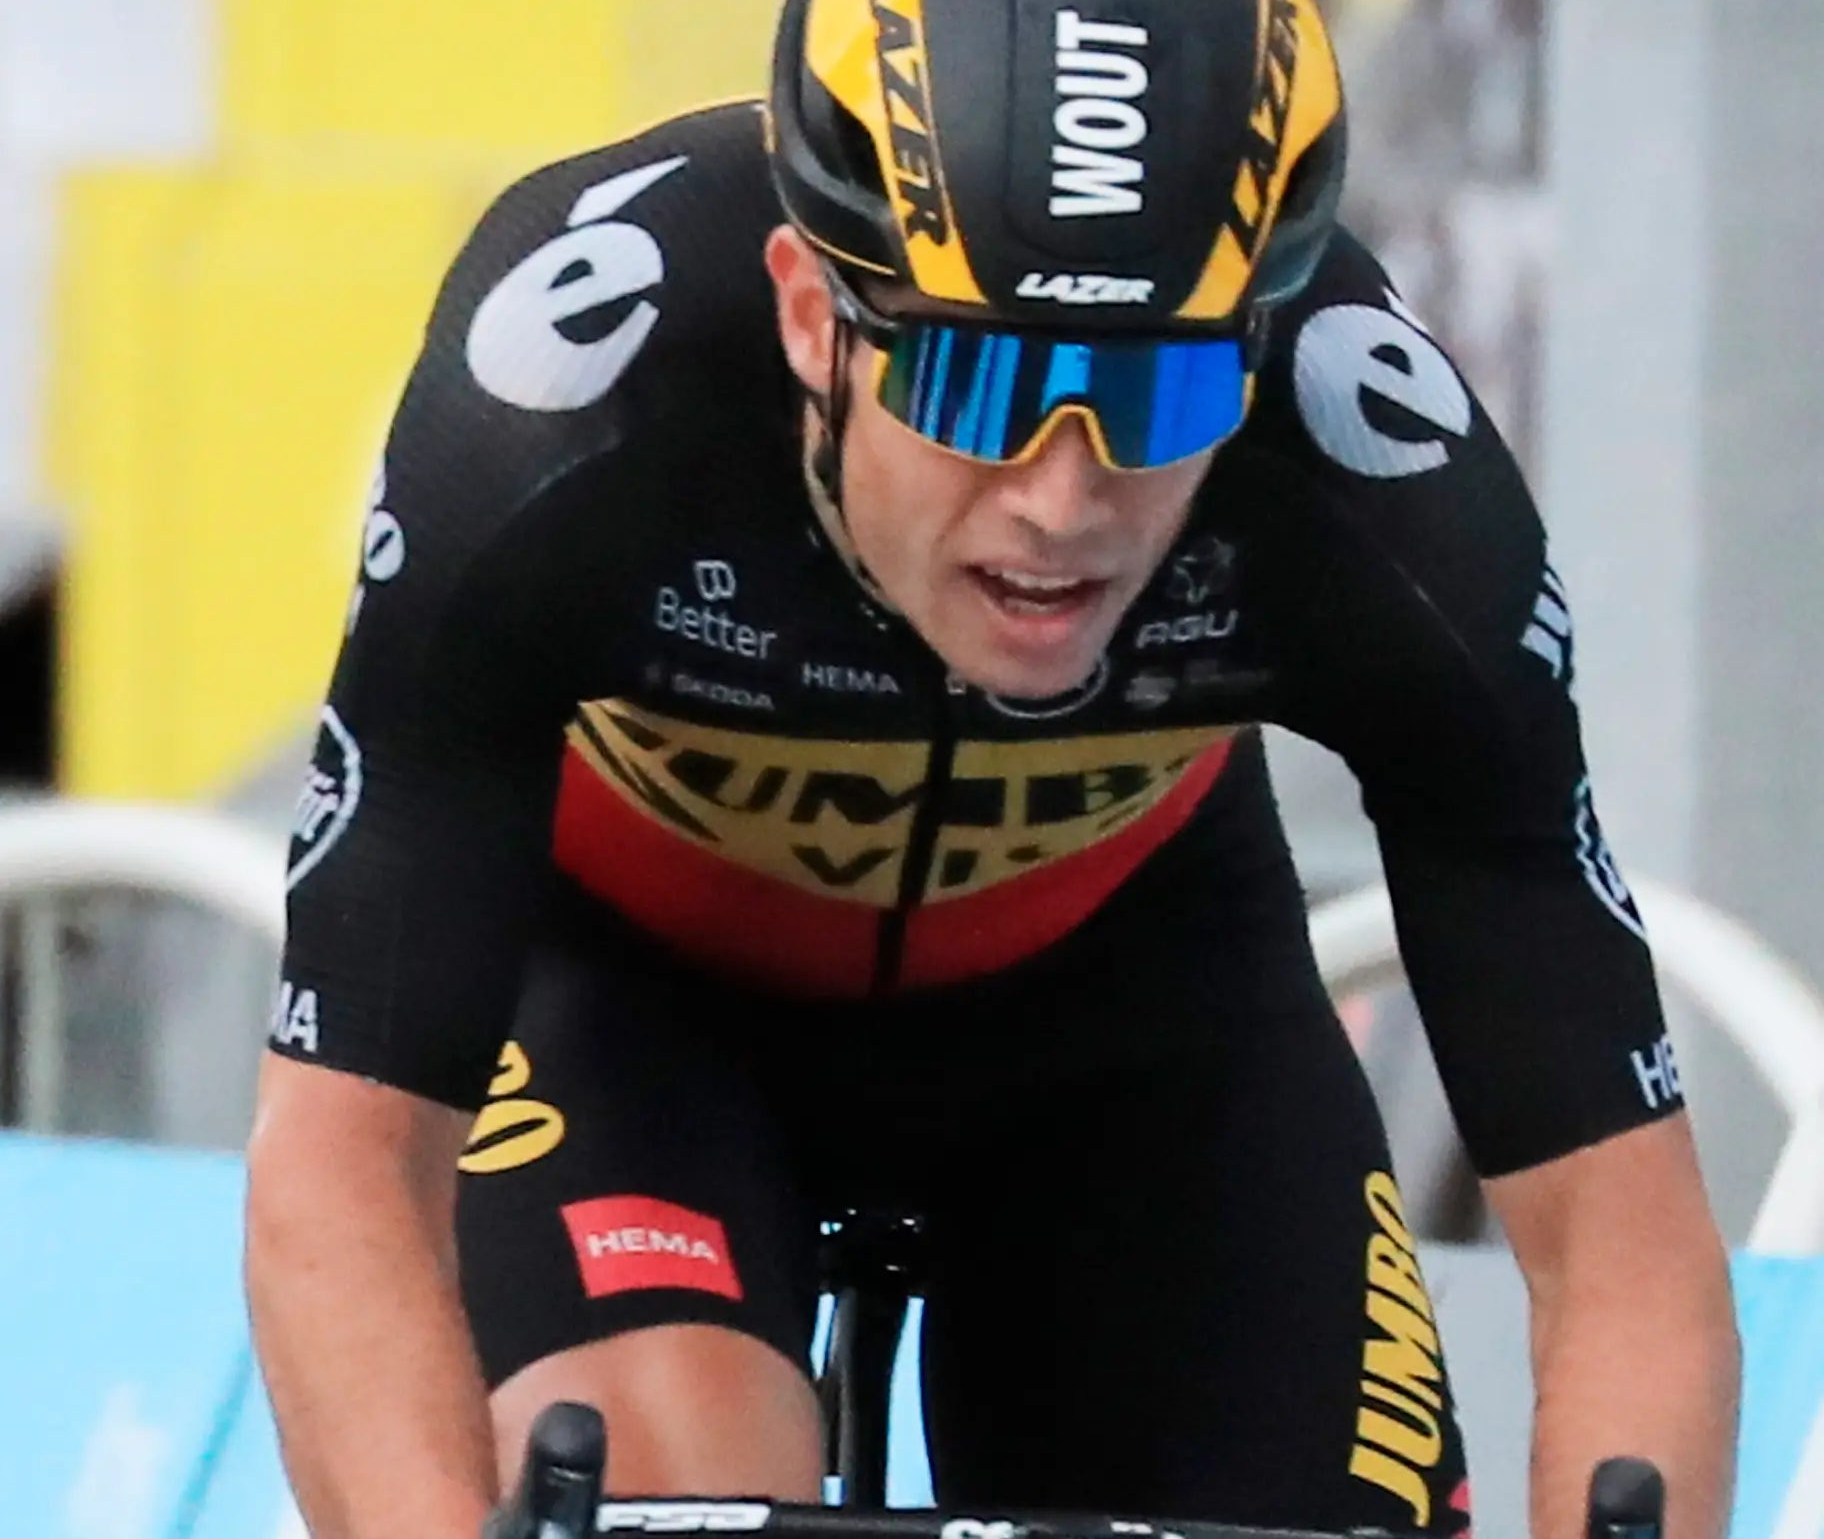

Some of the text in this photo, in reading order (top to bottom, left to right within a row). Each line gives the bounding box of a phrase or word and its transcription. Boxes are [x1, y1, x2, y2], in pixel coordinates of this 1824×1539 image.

[1049, 9, 1149, 218] WOUT
[1015, 271, 1155, 305] LAZER
[654, 585, 778, 660] Better
[1135, 609, 1239, 649] AGU
[801, 661, 901, 695] HEMA
[584, 1222, 722, 1267] HEMA
[1349, 1170, 1443, 1529] JUMBO
